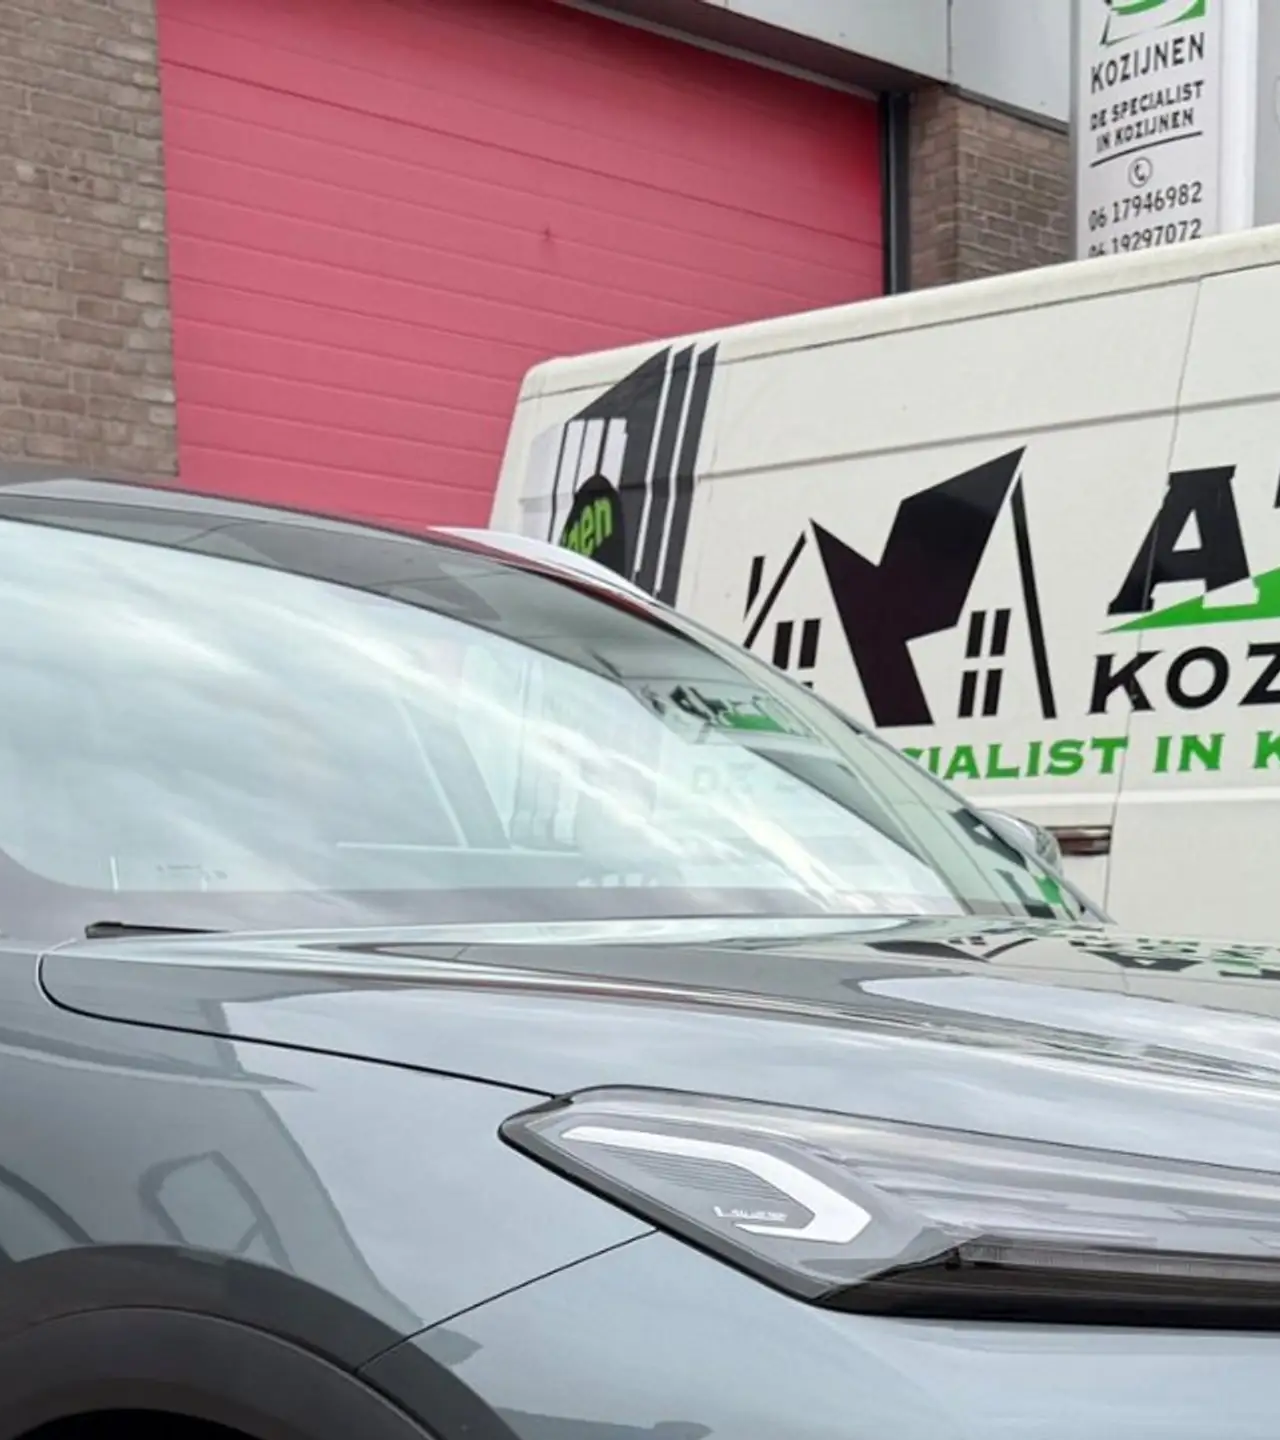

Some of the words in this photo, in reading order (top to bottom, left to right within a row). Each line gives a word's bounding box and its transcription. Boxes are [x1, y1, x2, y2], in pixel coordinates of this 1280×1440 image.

[1090, 31, 1205, 95] KOZIJNEN
[1090, 109, 1107, 132] DE
[1111, 79, 1205, 123] SPECIALIST
[1096, 132, 1111, 154] IN
[1114, 107, 1195, 147] KOZIJNEN
[1087, 206, 1108, 233] 06
[1111, 181, 1202, 224] 17946982
[1151, 733, 1226, 775] IN
